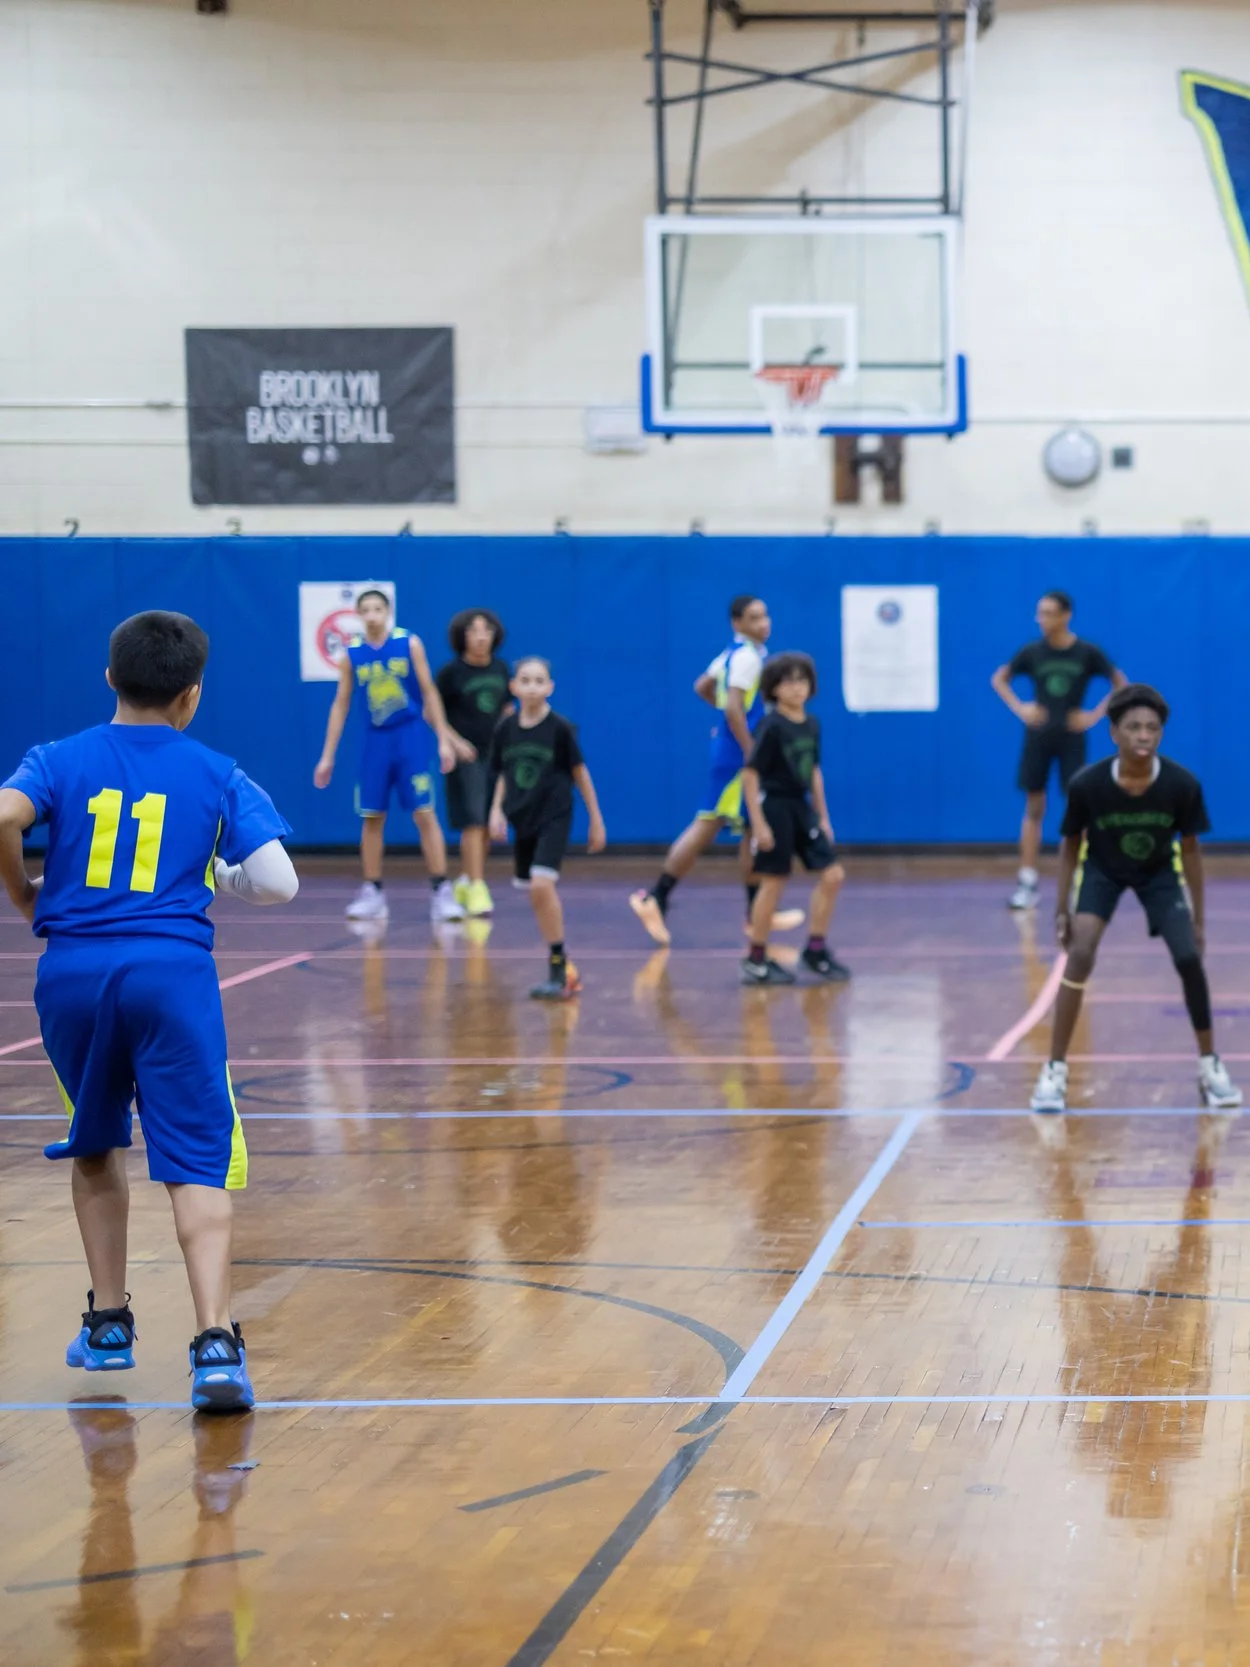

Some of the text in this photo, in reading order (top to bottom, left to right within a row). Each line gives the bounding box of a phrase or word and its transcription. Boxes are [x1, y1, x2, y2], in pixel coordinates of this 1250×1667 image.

[258, 369, 381, 408] BROOKLYN
[246, 405, 395, 444] BASKETBALL
[86, 787, 167, 893] 11
